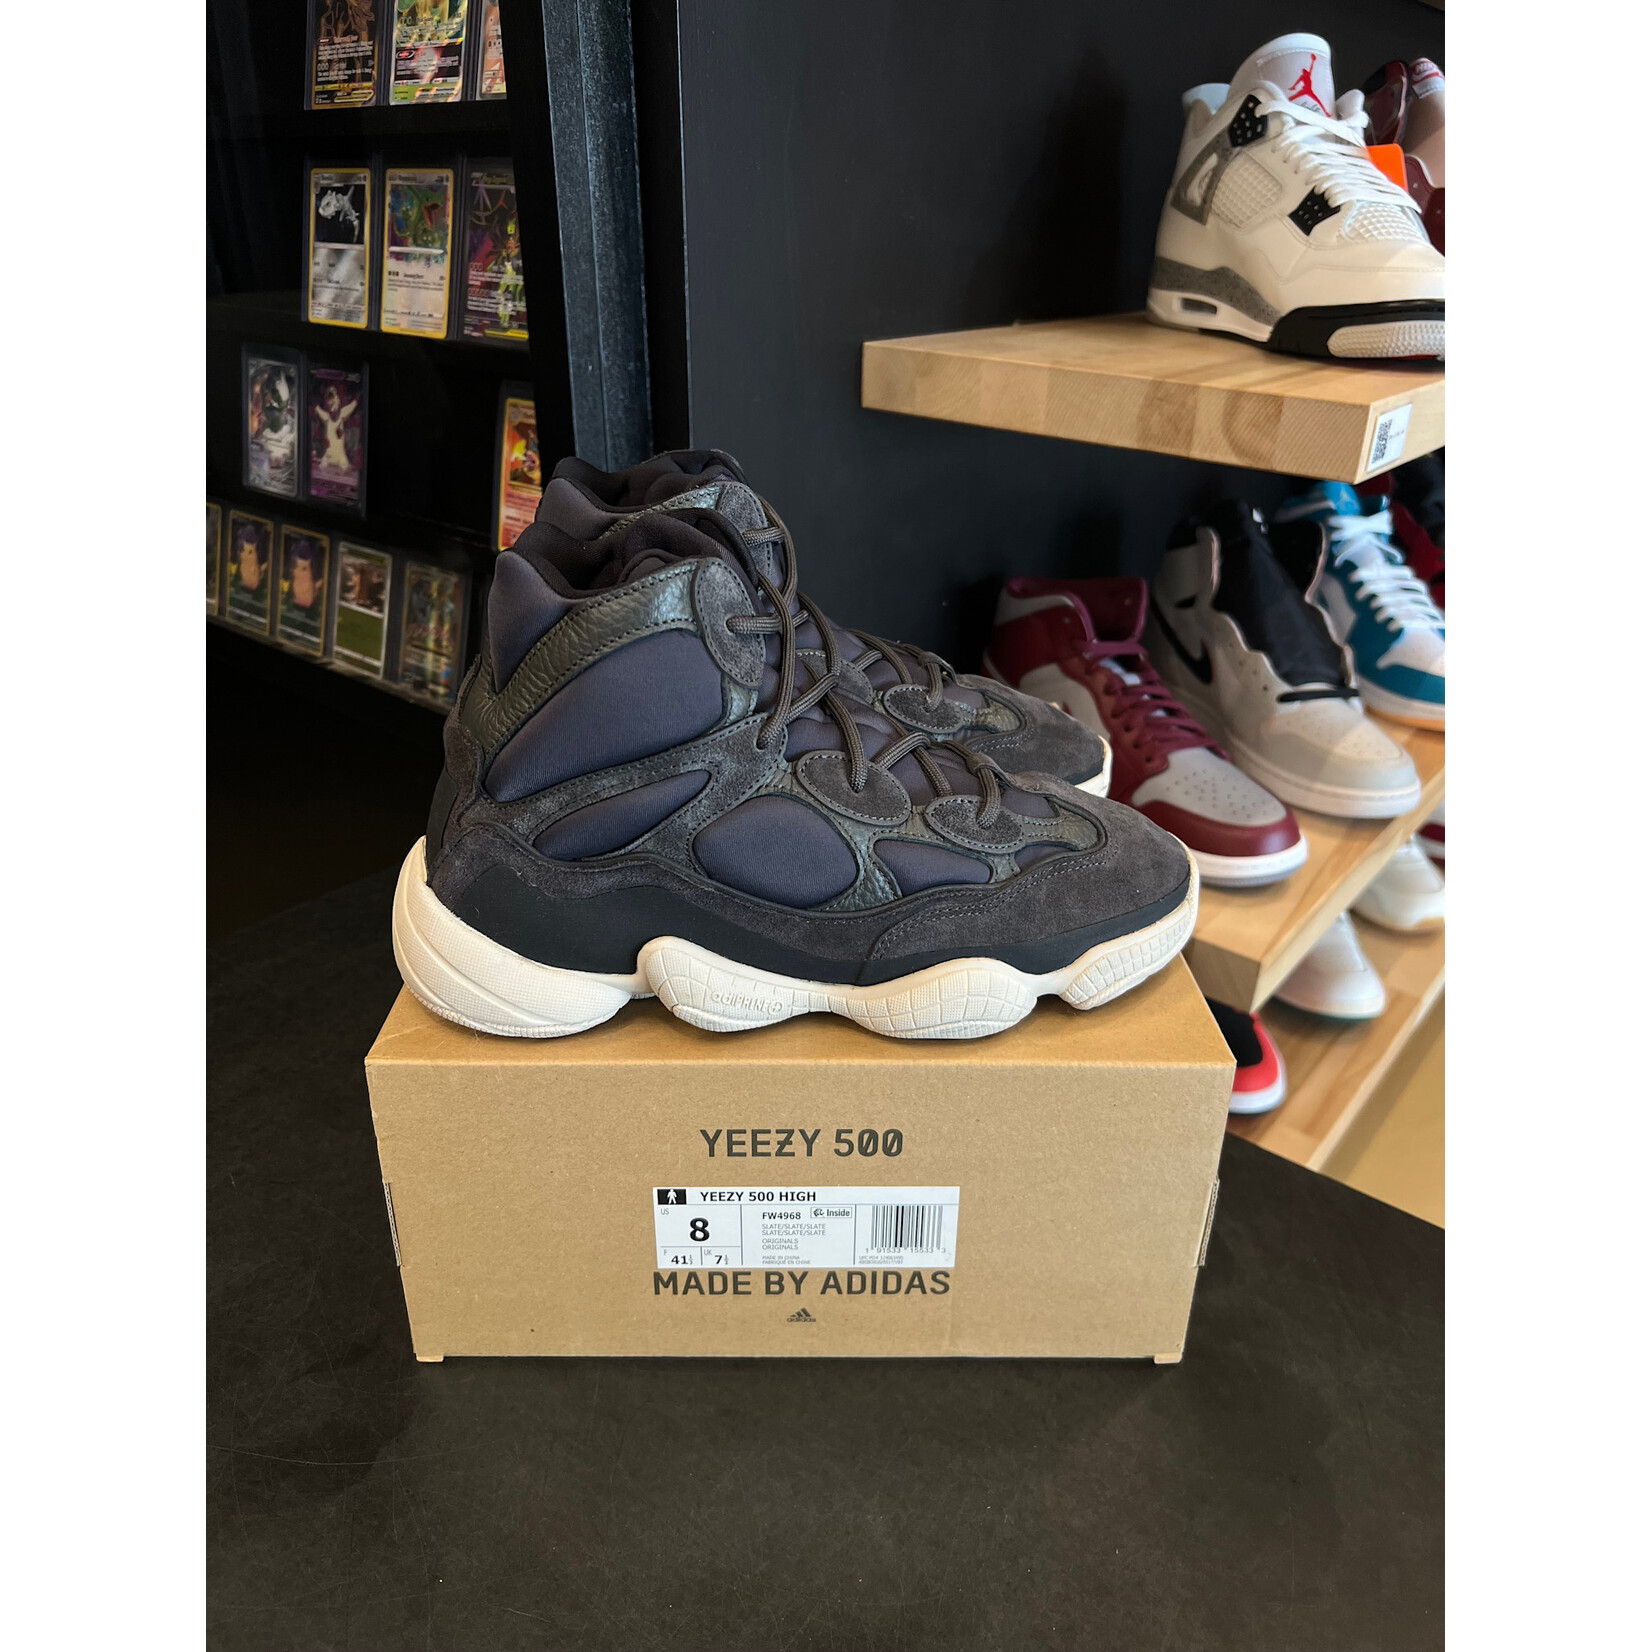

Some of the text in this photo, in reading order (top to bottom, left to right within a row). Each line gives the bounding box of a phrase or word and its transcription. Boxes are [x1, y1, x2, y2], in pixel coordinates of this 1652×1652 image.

[699, 1128, 904, 1158] YEEZY 500
[700, 1191, 817, 1202] YEEZY 500 HIGH
[762, 1211, 802, 1220] FW4968
[826, 1208, 850, 1217] Inside
[689, 1217, 710, 1242] 8
[653, 1270, 951, 1296] MADE BY ADIDAS
